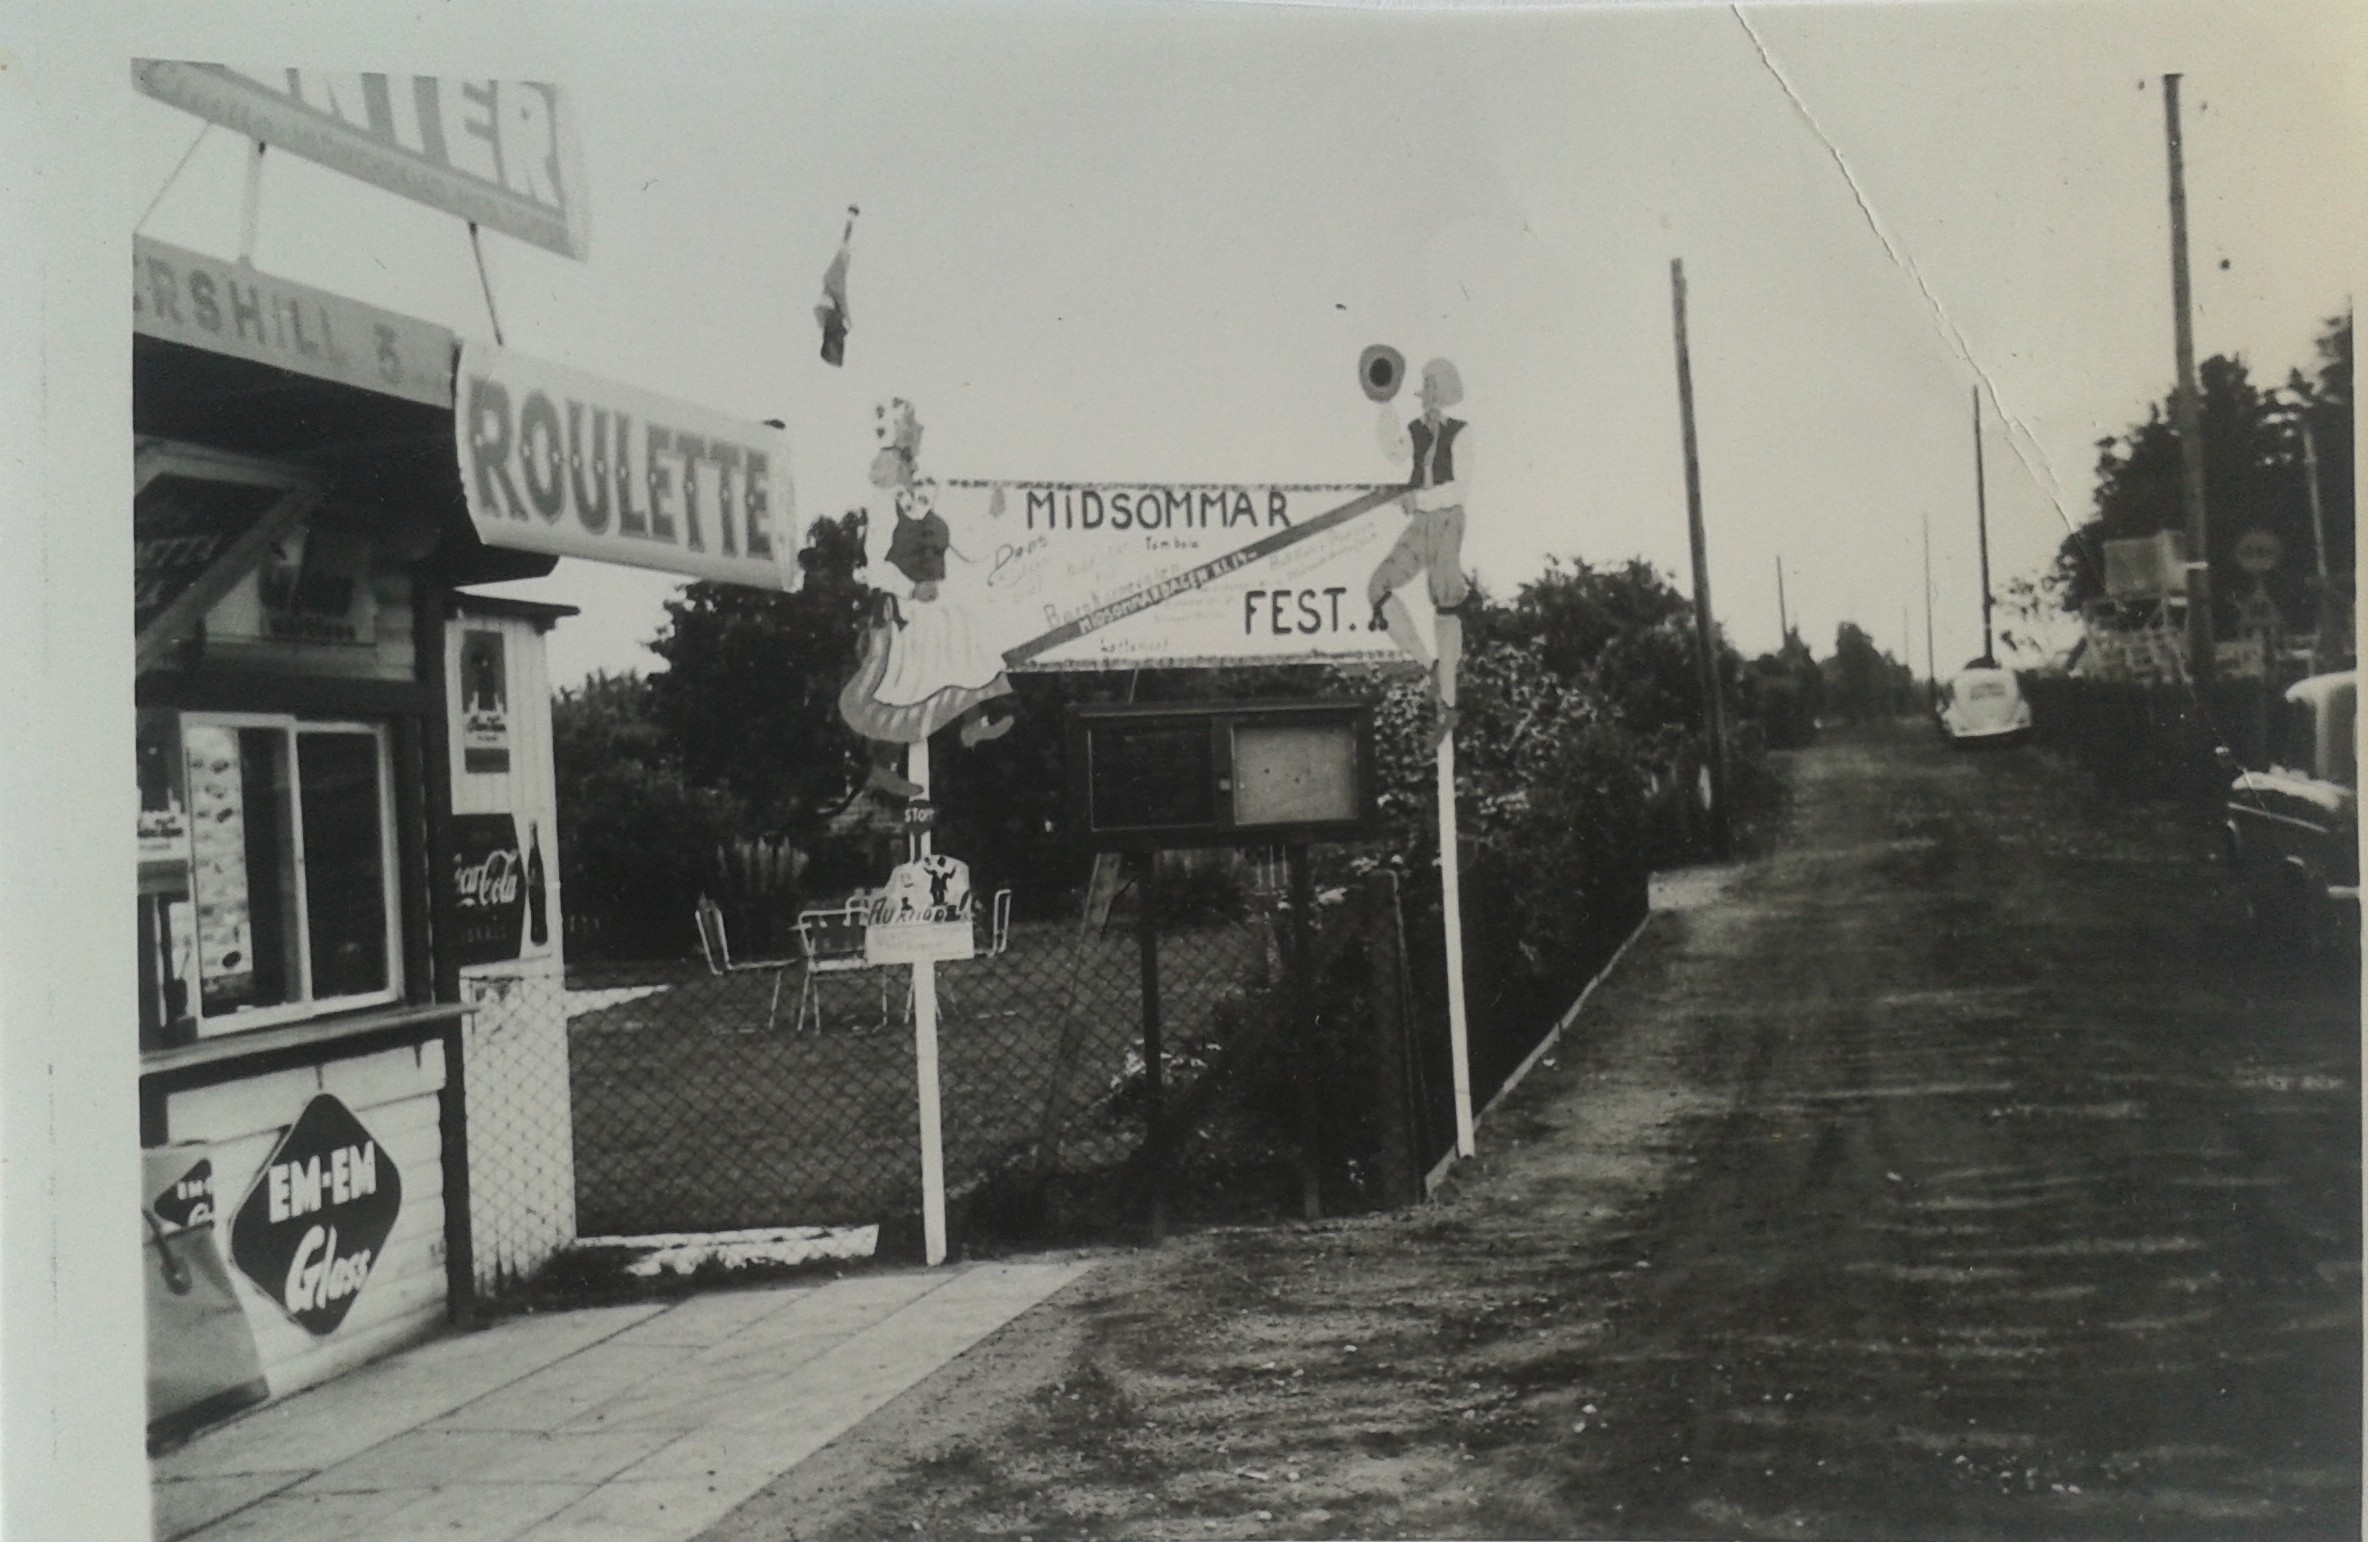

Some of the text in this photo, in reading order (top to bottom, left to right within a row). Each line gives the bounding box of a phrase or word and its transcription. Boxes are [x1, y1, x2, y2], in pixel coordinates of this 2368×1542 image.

[133, 252, 349, 368] RSHILL
[467, 377, 775, 560] ROULETTE
[1026, 490, 1292, 530] MIDSOMMAR
[1244, 587, 1357, 636] FEST.
[268, 1141, 377, 1223] EM-EM
